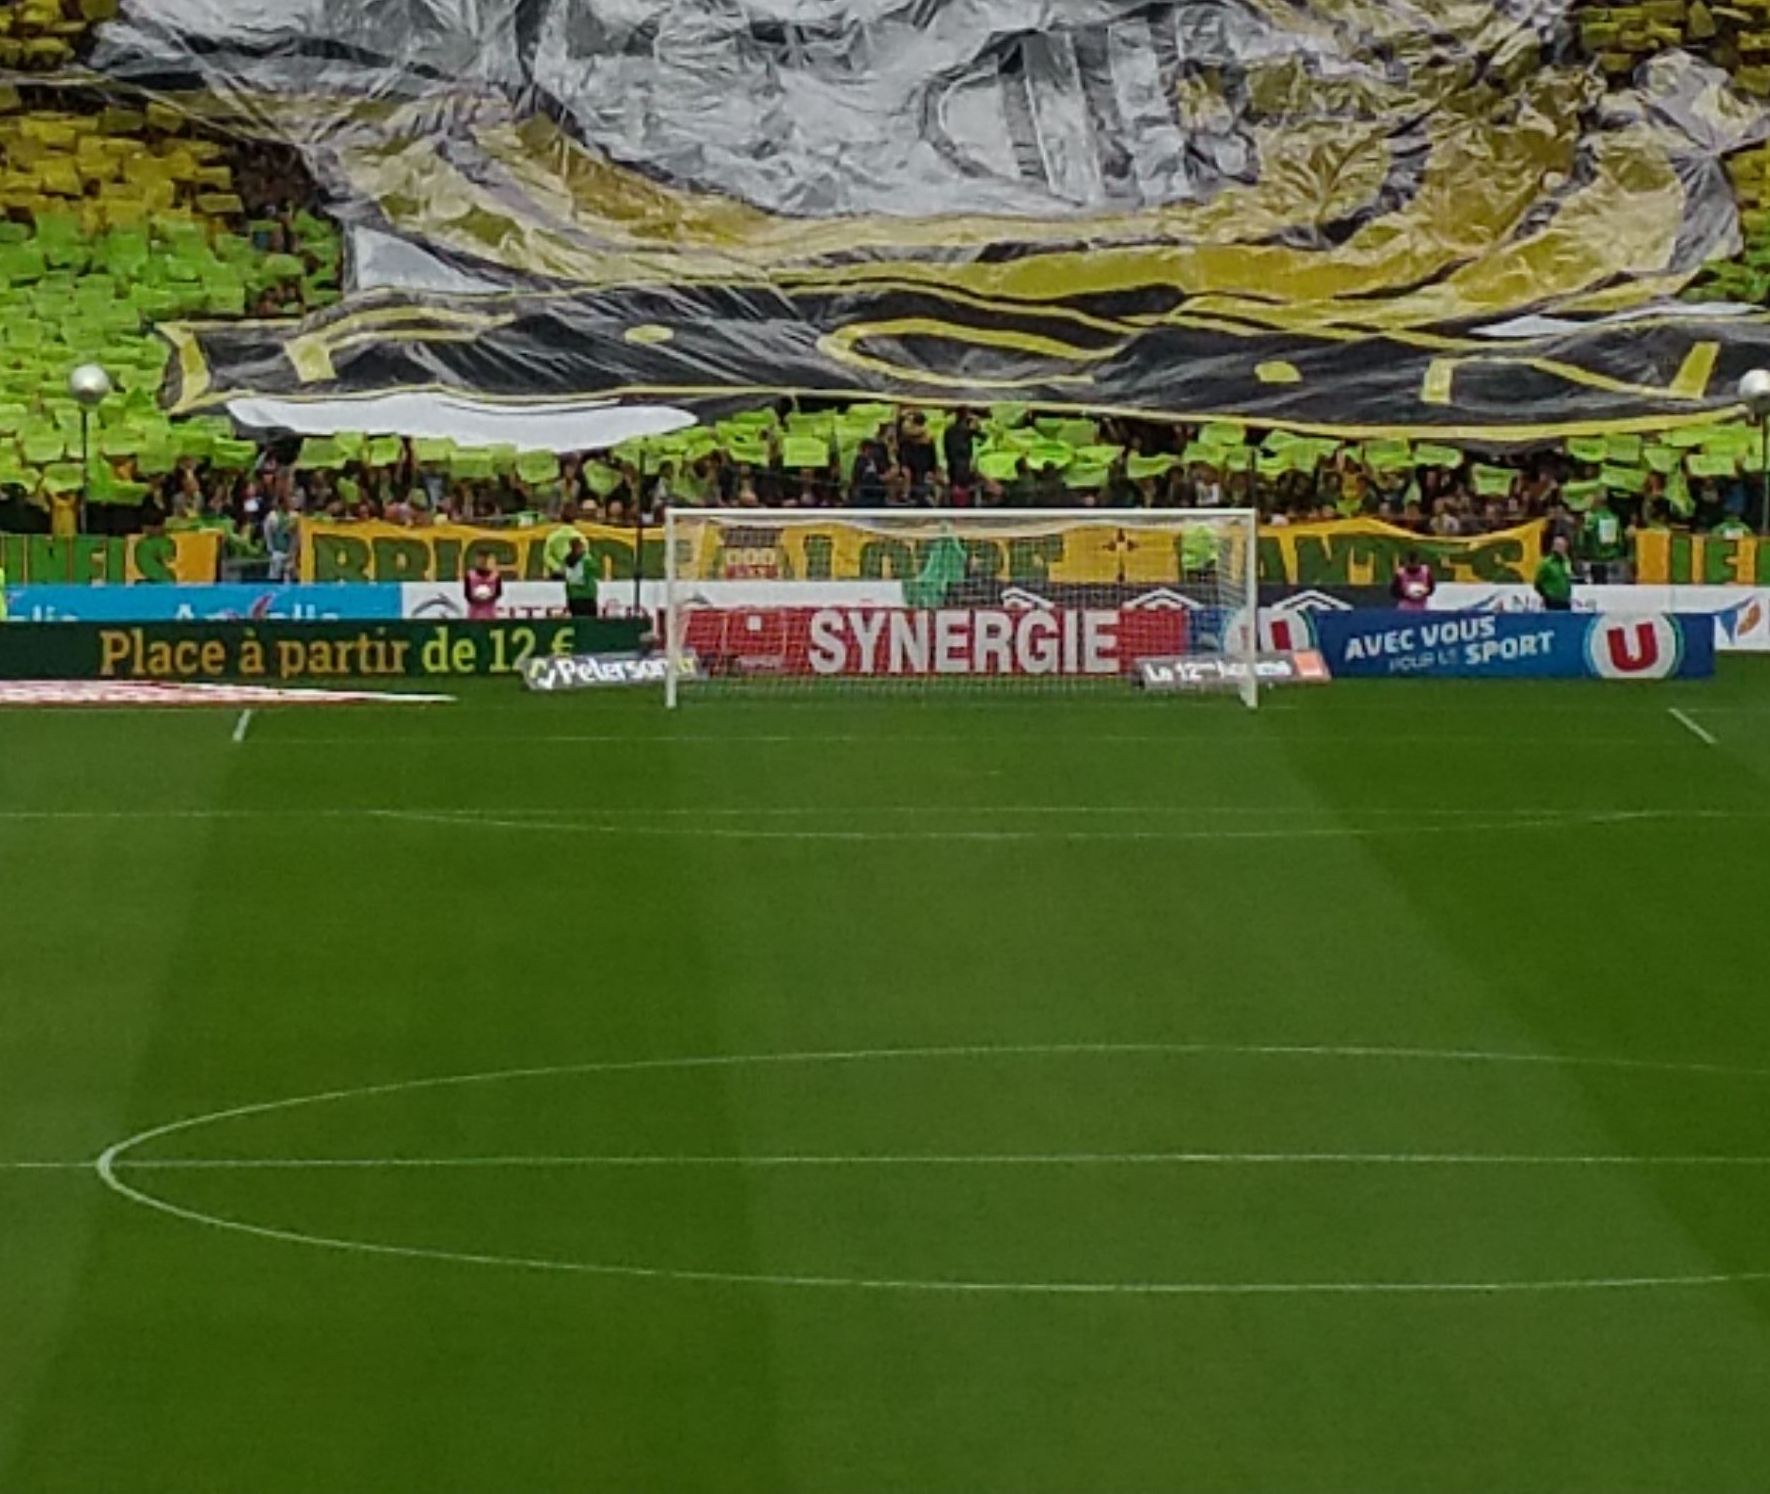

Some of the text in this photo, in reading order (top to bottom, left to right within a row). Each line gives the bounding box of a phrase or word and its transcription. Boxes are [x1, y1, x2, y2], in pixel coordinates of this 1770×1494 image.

[99, 627, 225, 676] Place
[238, 628, 265, 674] à
[278, 628, 411, 678] partir
[421, 627, 477, 674] de
[489, 628, 537, 673] 12
[809, 608, 1122, 674] SYNERGIE
[1345, 614, 1496, 661] AVEC VOUS
[1465, 630, 1556, 666] SPORT
